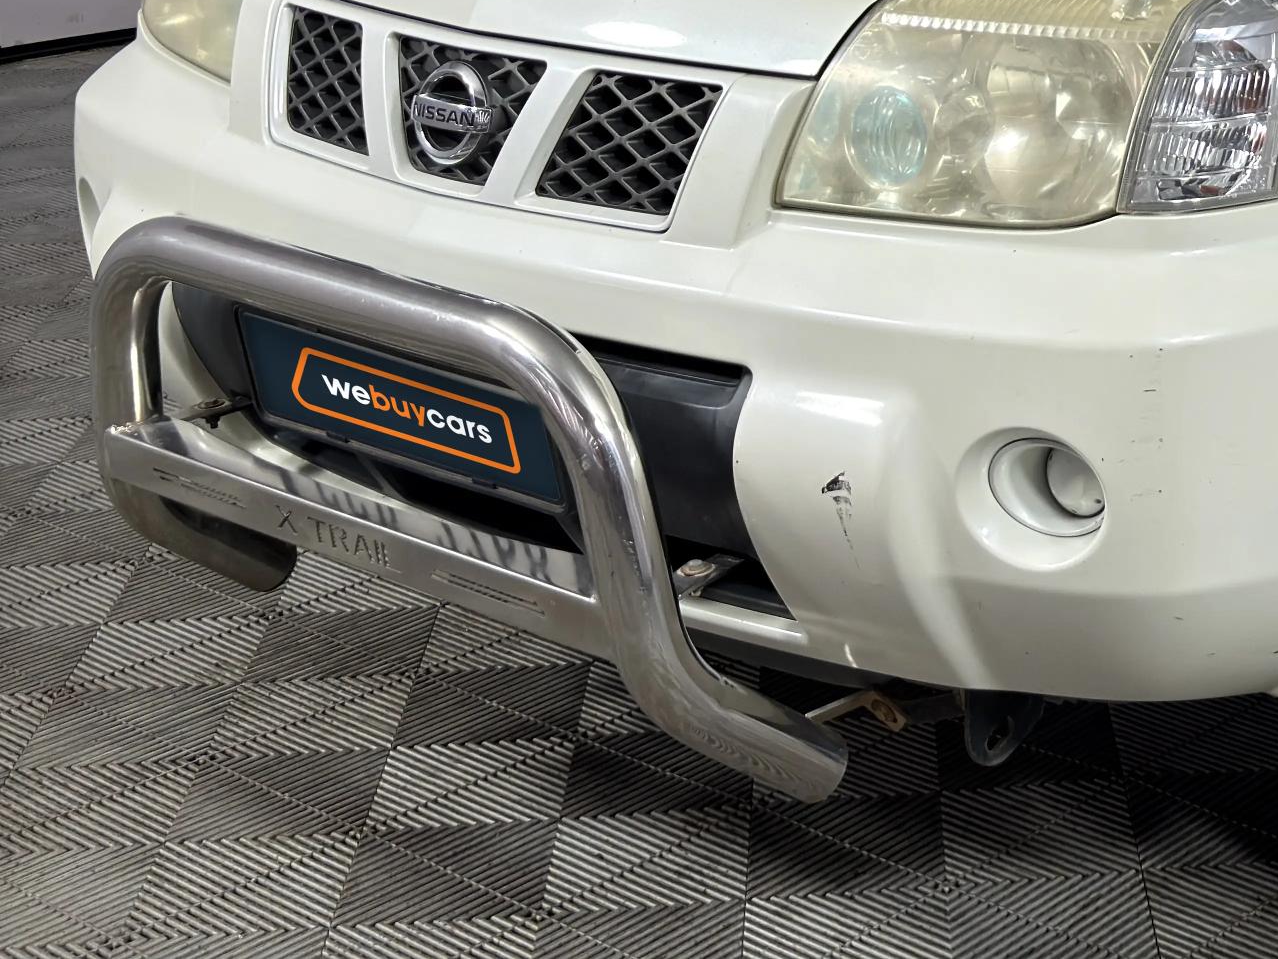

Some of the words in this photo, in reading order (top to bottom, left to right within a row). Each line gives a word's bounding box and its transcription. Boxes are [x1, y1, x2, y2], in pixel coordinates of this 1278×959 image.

[413, 102, 475, 127] NISSAN
[321, 374, 493, 444] webuycars
[276, 504, 298, 536] X
